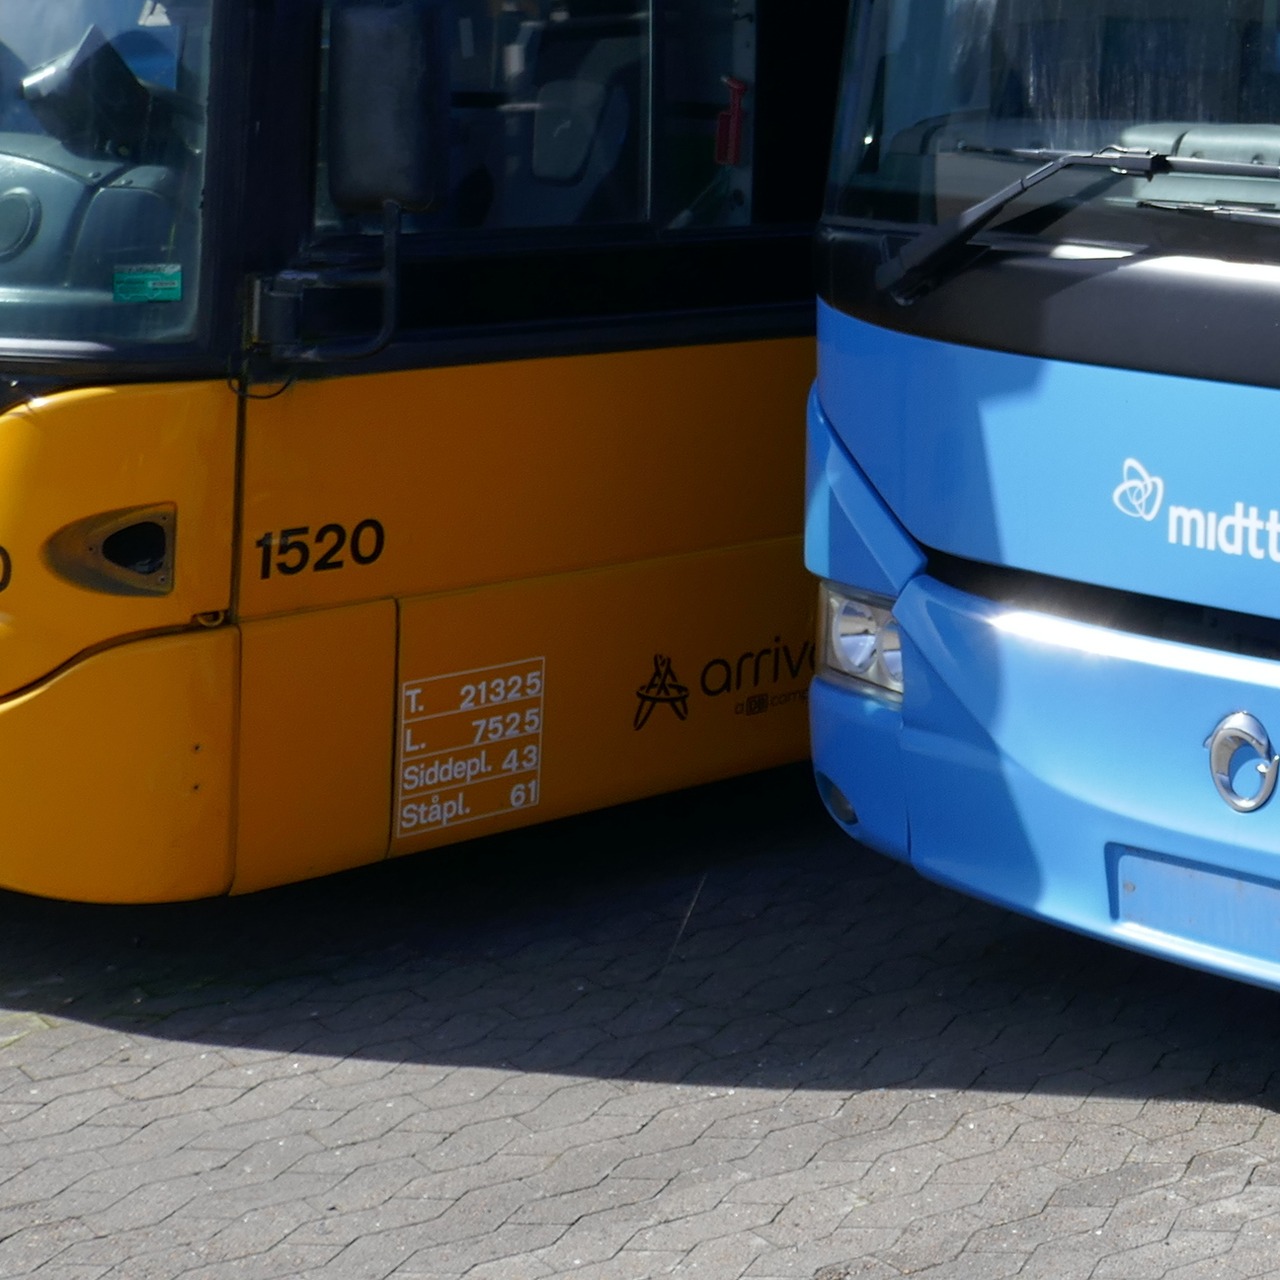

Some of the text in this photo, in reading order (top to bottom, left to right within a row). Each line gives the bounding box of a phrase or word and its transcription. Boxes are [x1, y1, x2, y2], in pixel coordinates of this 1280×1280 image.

[255, 518, 385, 579] 1520
[404, 671, 542, 713] T. 21325
[405, 707, 540, 752] L. 7525
[403, 744, 539, 791] Siddepl. 43
[401, 779, 538, 828] Ståpl. 61
